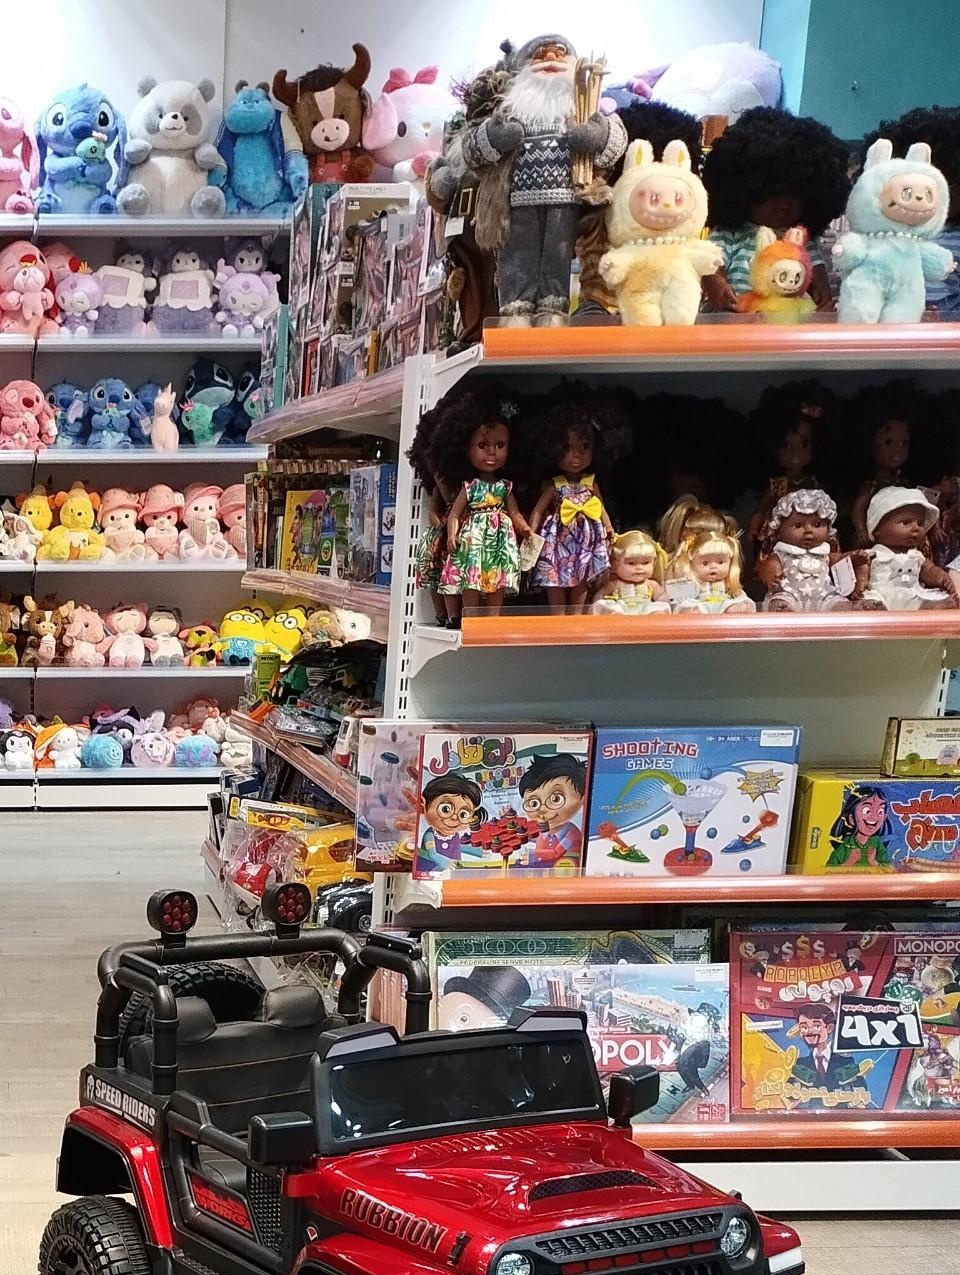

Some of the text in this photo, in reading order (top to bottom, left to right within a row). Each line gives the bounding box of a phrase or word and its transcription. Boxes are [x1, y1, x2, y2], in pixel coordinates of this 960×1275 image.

[625, 758, 674, 771] GAMES
[841, 1014, 922, 1046] 4x1
[95, 1078, 156, 1127] SPEED RIDERS
[339, 1186, 449, 1254] RUBBION
